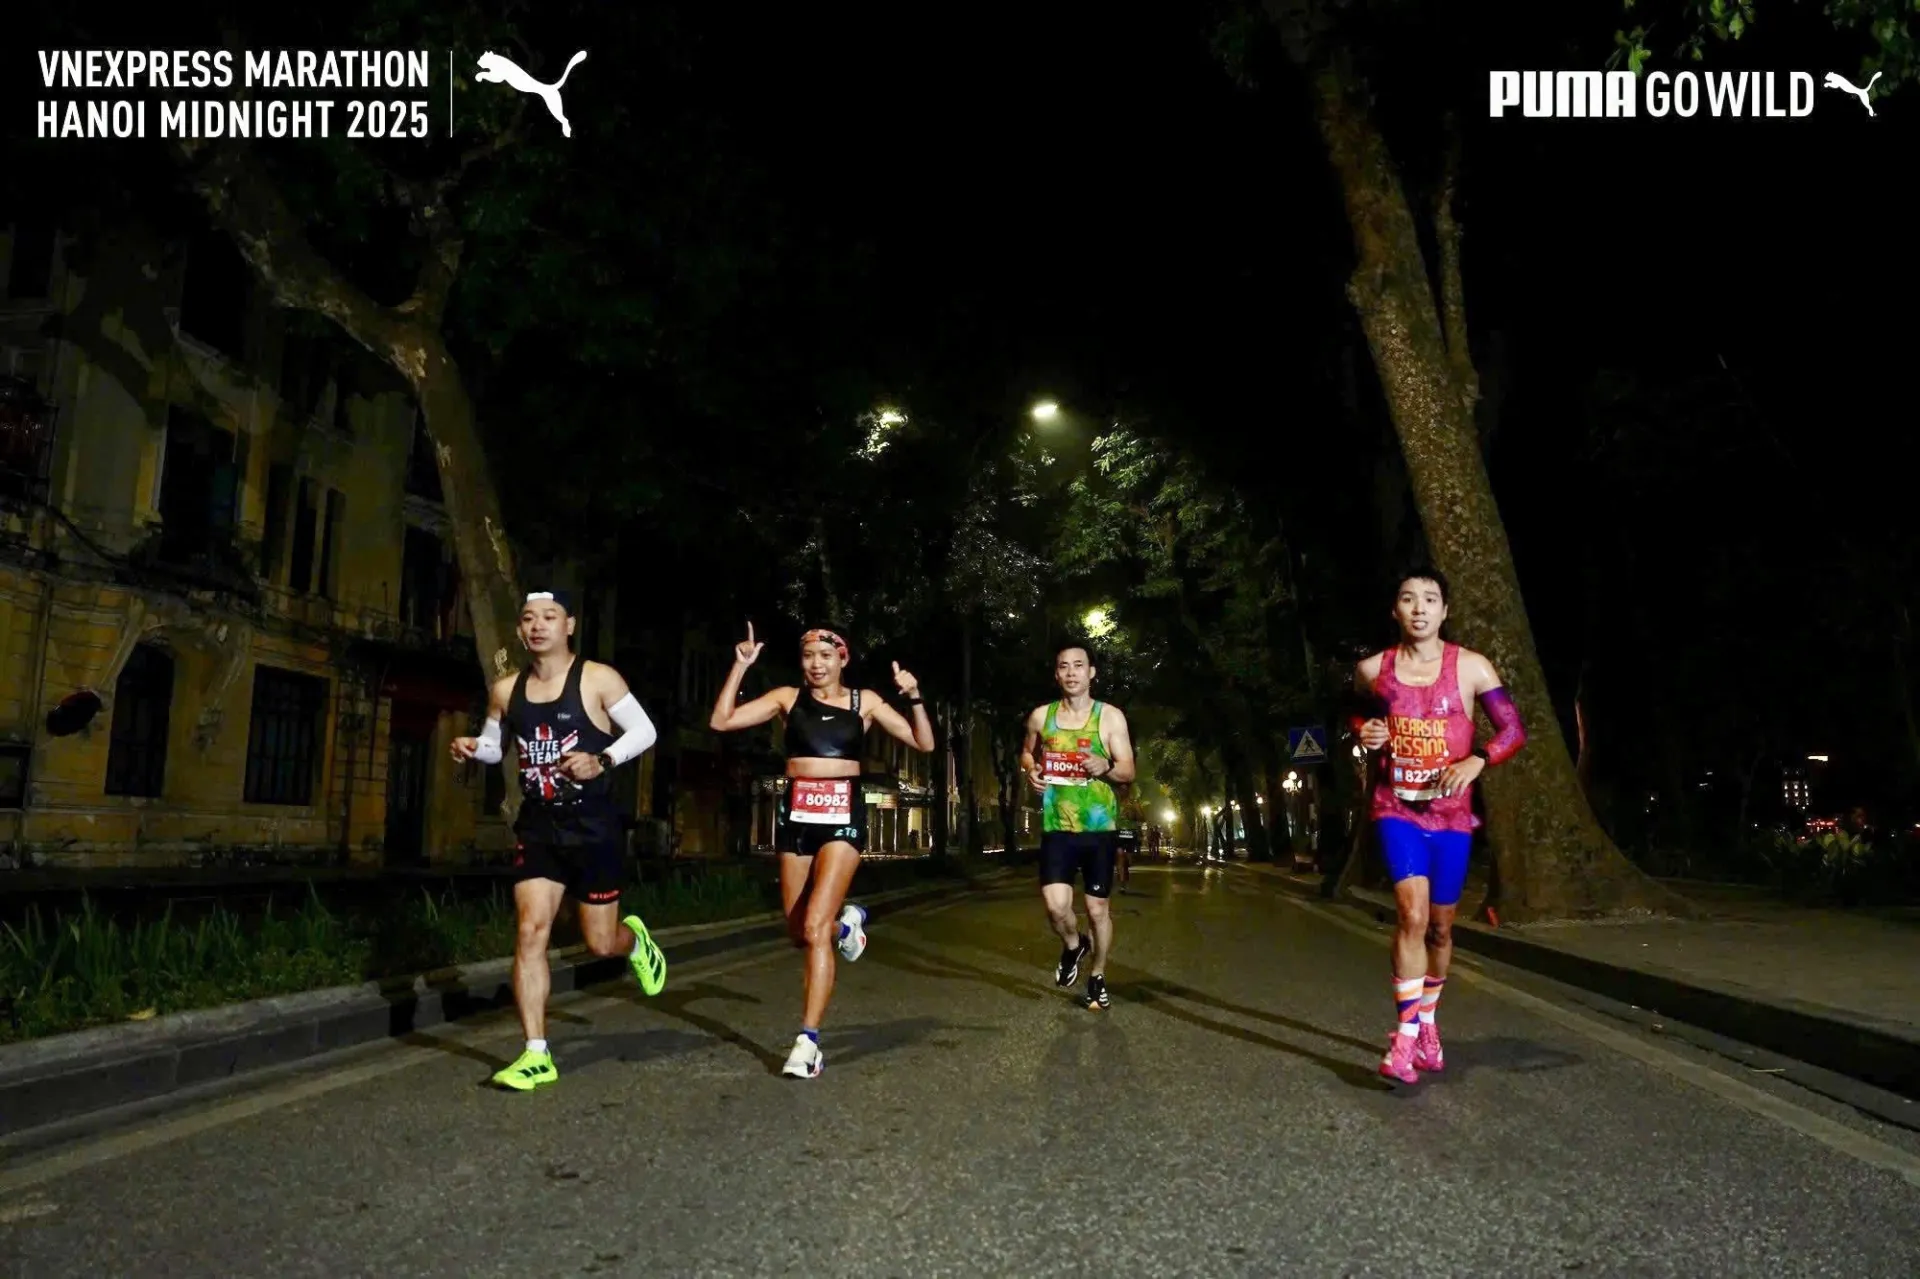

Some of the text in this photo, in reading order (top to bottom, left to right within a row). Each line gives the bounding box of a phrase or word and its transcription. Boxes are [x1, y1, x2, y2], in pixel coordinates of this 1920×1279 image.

[1394, 716, 1431, 737] YEARS
[528, 740, 559, 752] ELITE
[1394, 735, 1447, 756] ASSION
[529, 751, 561, 765] TEAM
[805, 793, 849, 807] 80982
